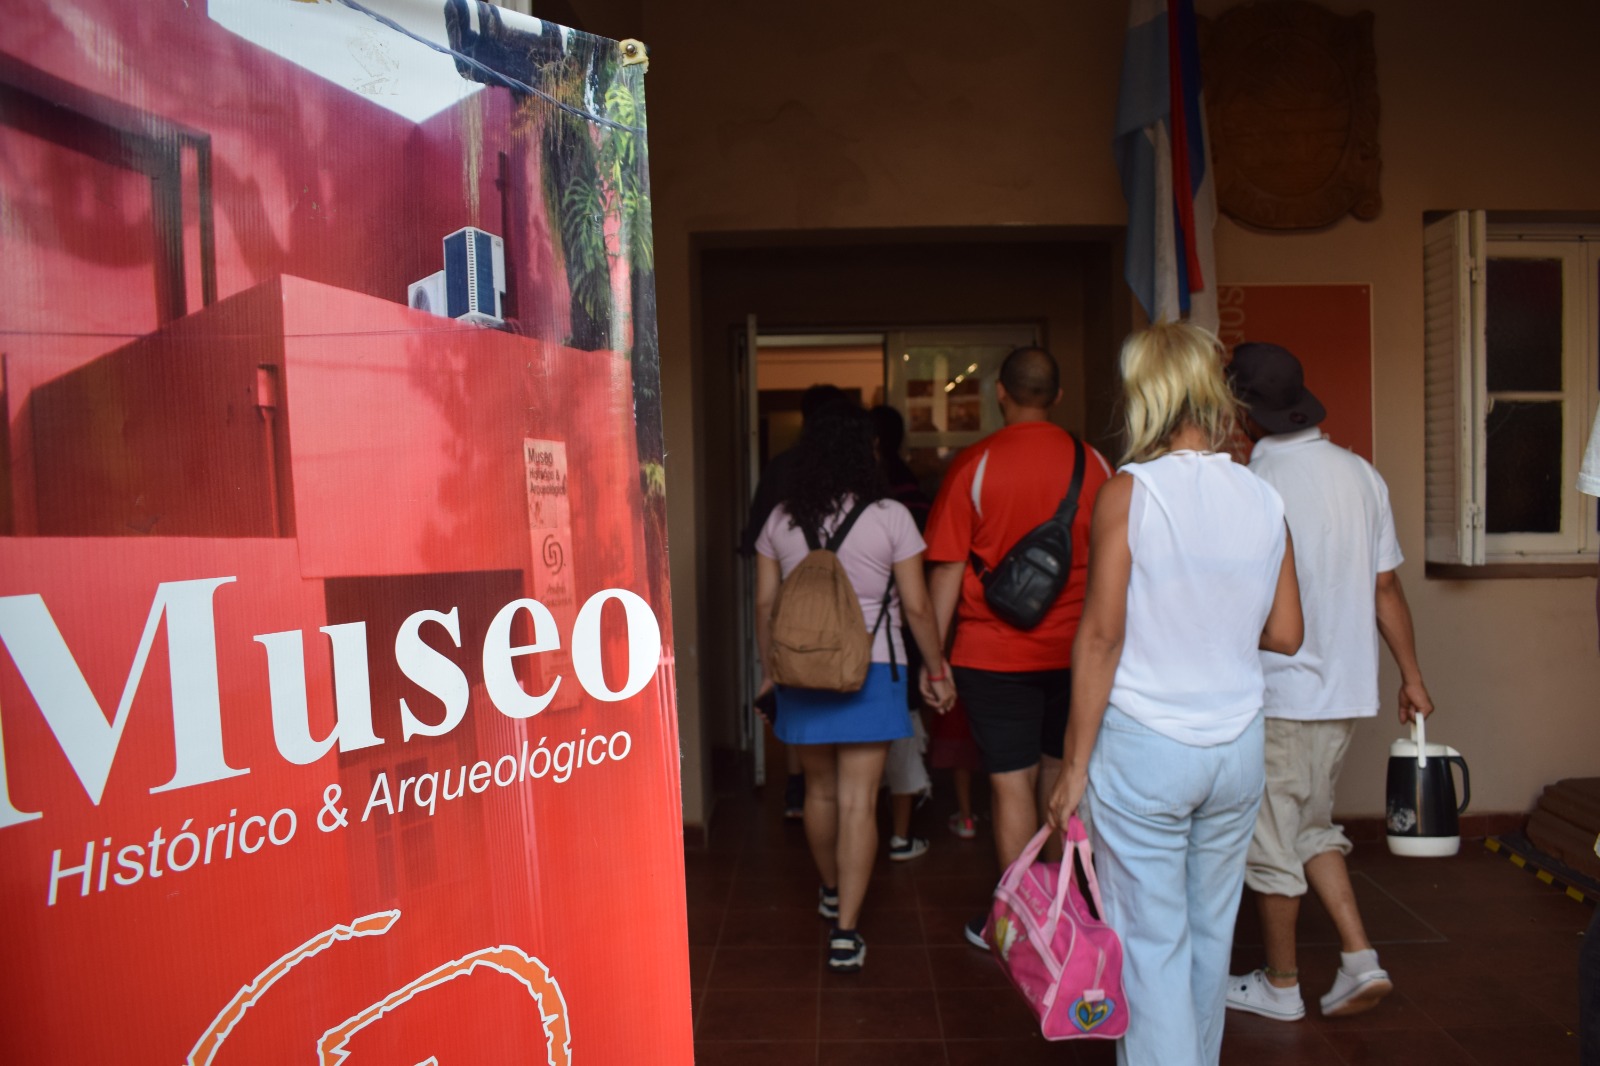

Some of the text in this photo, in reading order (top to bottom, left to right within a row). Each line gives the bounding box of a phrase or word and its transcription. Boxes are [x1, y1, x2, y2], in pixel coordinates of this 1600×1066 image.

[528, 448, 553, 466] Museo
[0, 575, 662, 829] Museo
[47, 730, 633, 907] Histórico & Arqueológico
